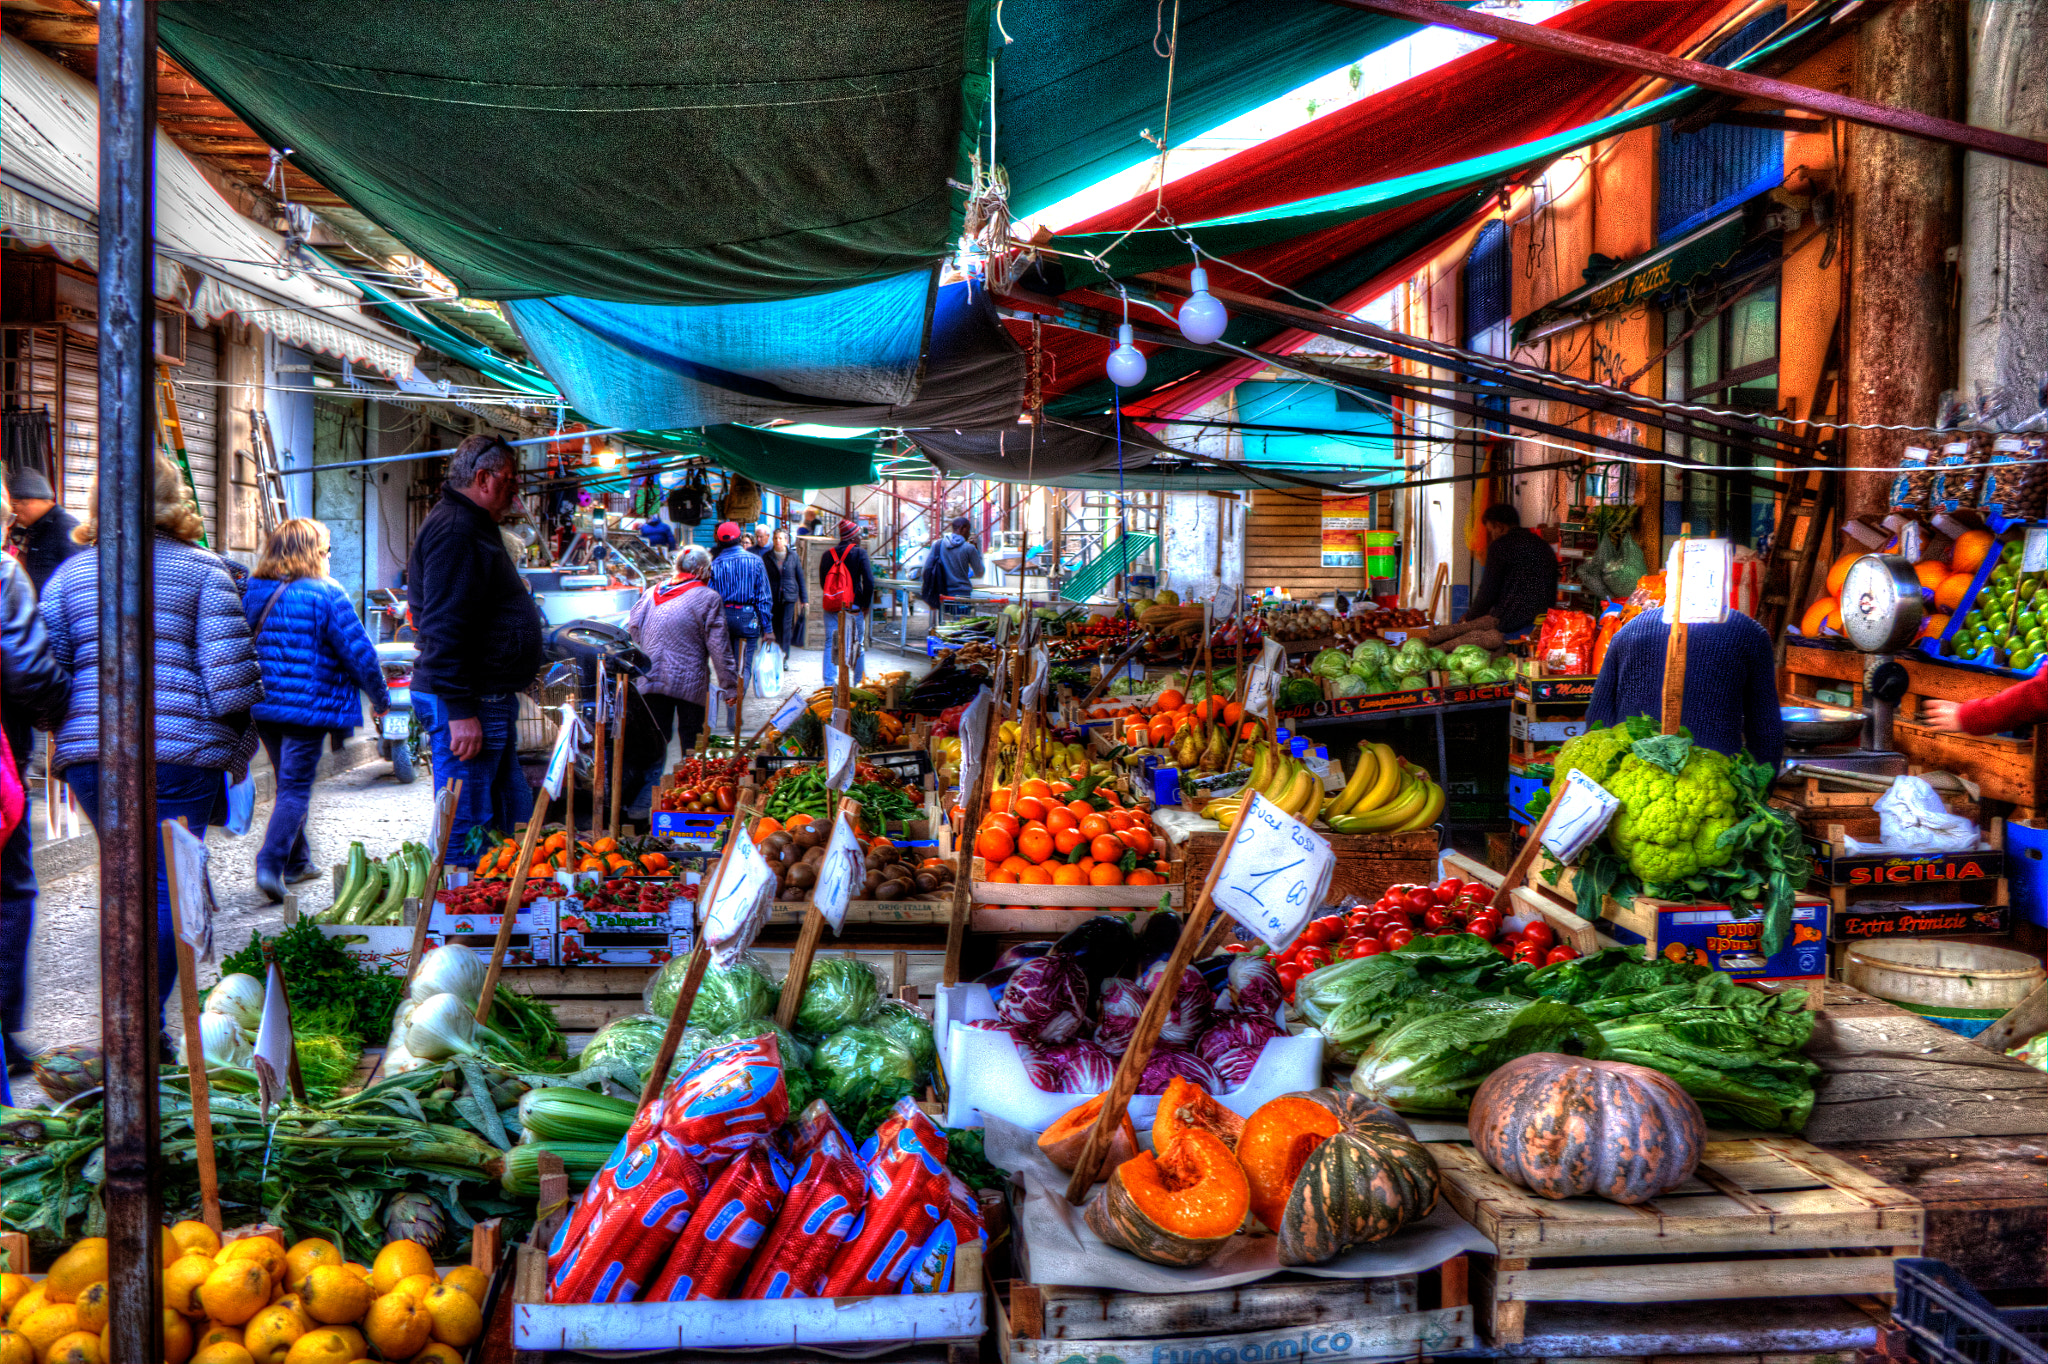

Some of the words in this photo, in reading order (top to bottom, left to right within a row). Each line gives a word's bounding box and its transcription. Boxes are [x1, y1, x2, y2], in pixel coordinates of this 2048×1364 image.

[1849, 861, 1985, 885] SICILIA
[903, 903, 932, 912] ITALIA
[595, 914, 658, 927] Palmeri
[1845, 917, 1895, 938] Extra
[1897, 912, 1968, 933] Primizie
